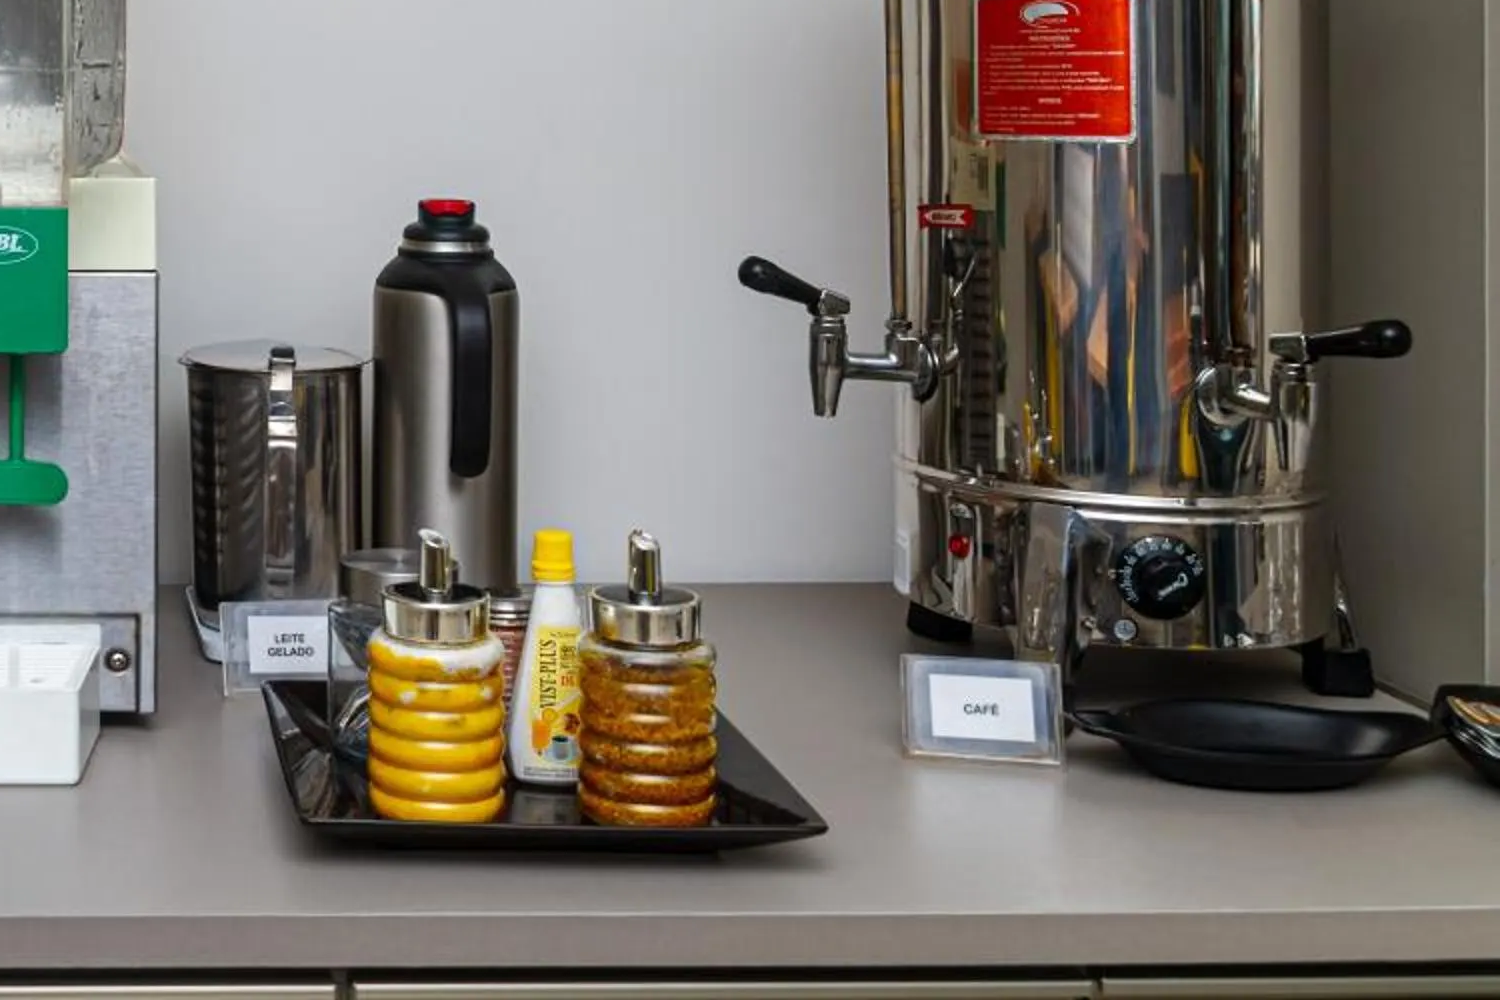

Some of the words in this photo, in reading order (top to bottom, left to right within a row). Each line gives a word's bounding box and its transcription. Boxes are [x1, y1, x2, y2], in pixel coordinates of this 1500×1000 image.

[274, 633, 305, 644] LEITE
[267, 646, 315, 657] GELADO
[963, 702, 1000, 717] CAFÉ
